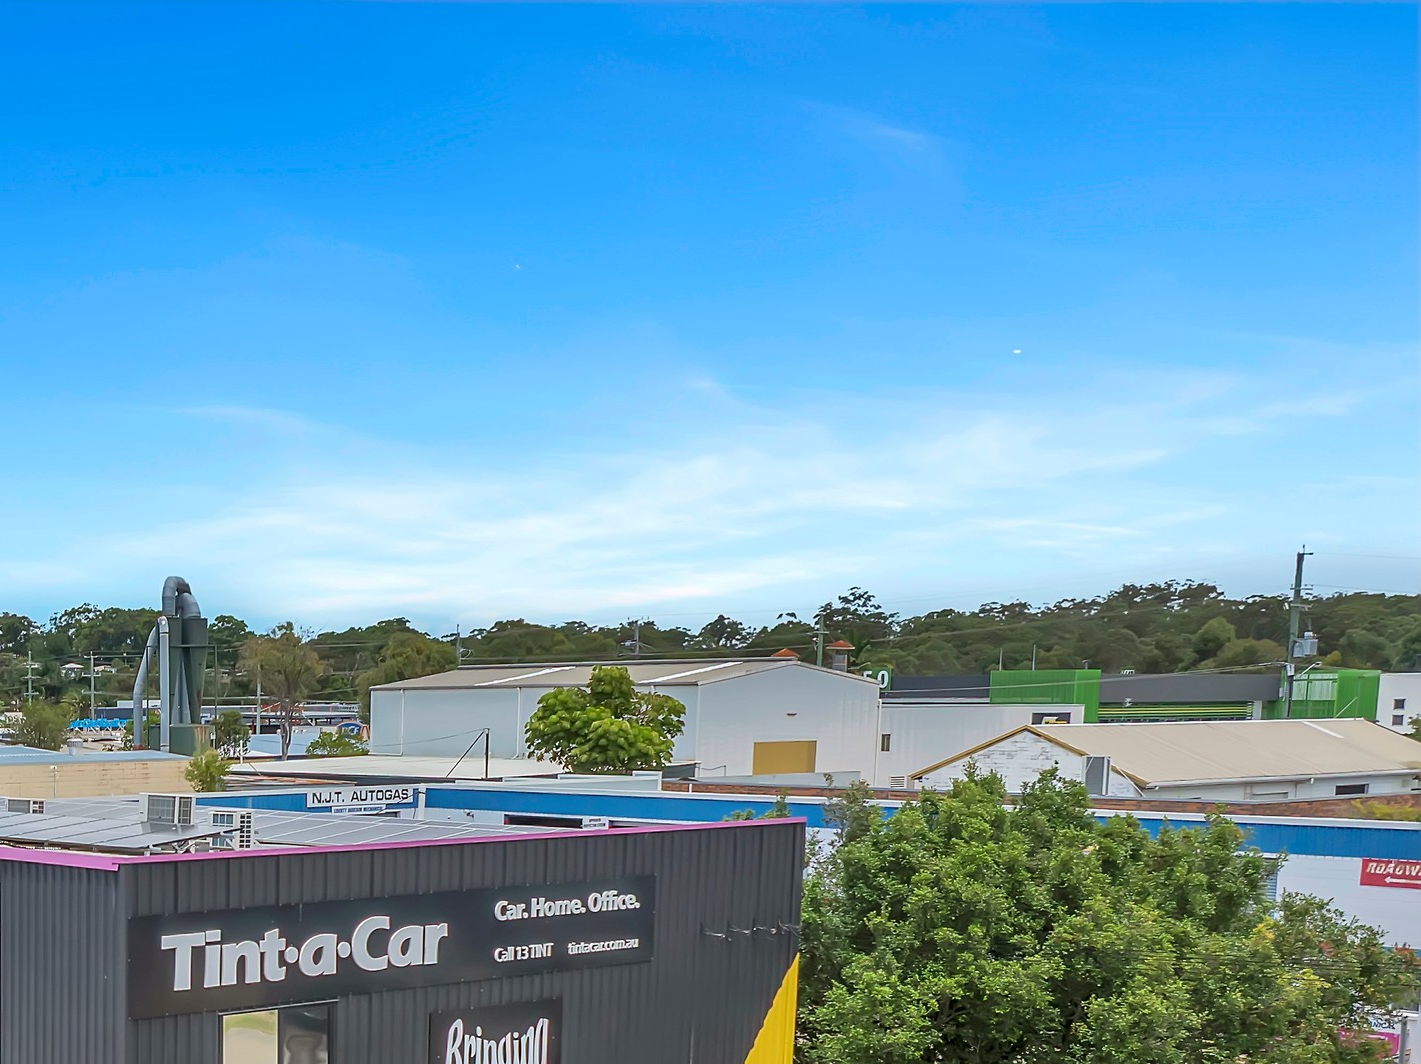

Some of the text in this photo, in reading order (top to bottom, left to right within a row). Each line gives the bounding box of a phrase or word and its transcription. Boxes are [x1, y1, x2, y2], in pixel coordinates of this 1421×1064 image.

[312, 788, 409, 803] N.J.T. AUTOGAS
[1366, 862, 1421, 876] ROADW
[494, 890, 641, 921] Car. Home. Office.
[494, 947, 515, 963] Call
[516, 945, 529, 960] 13
